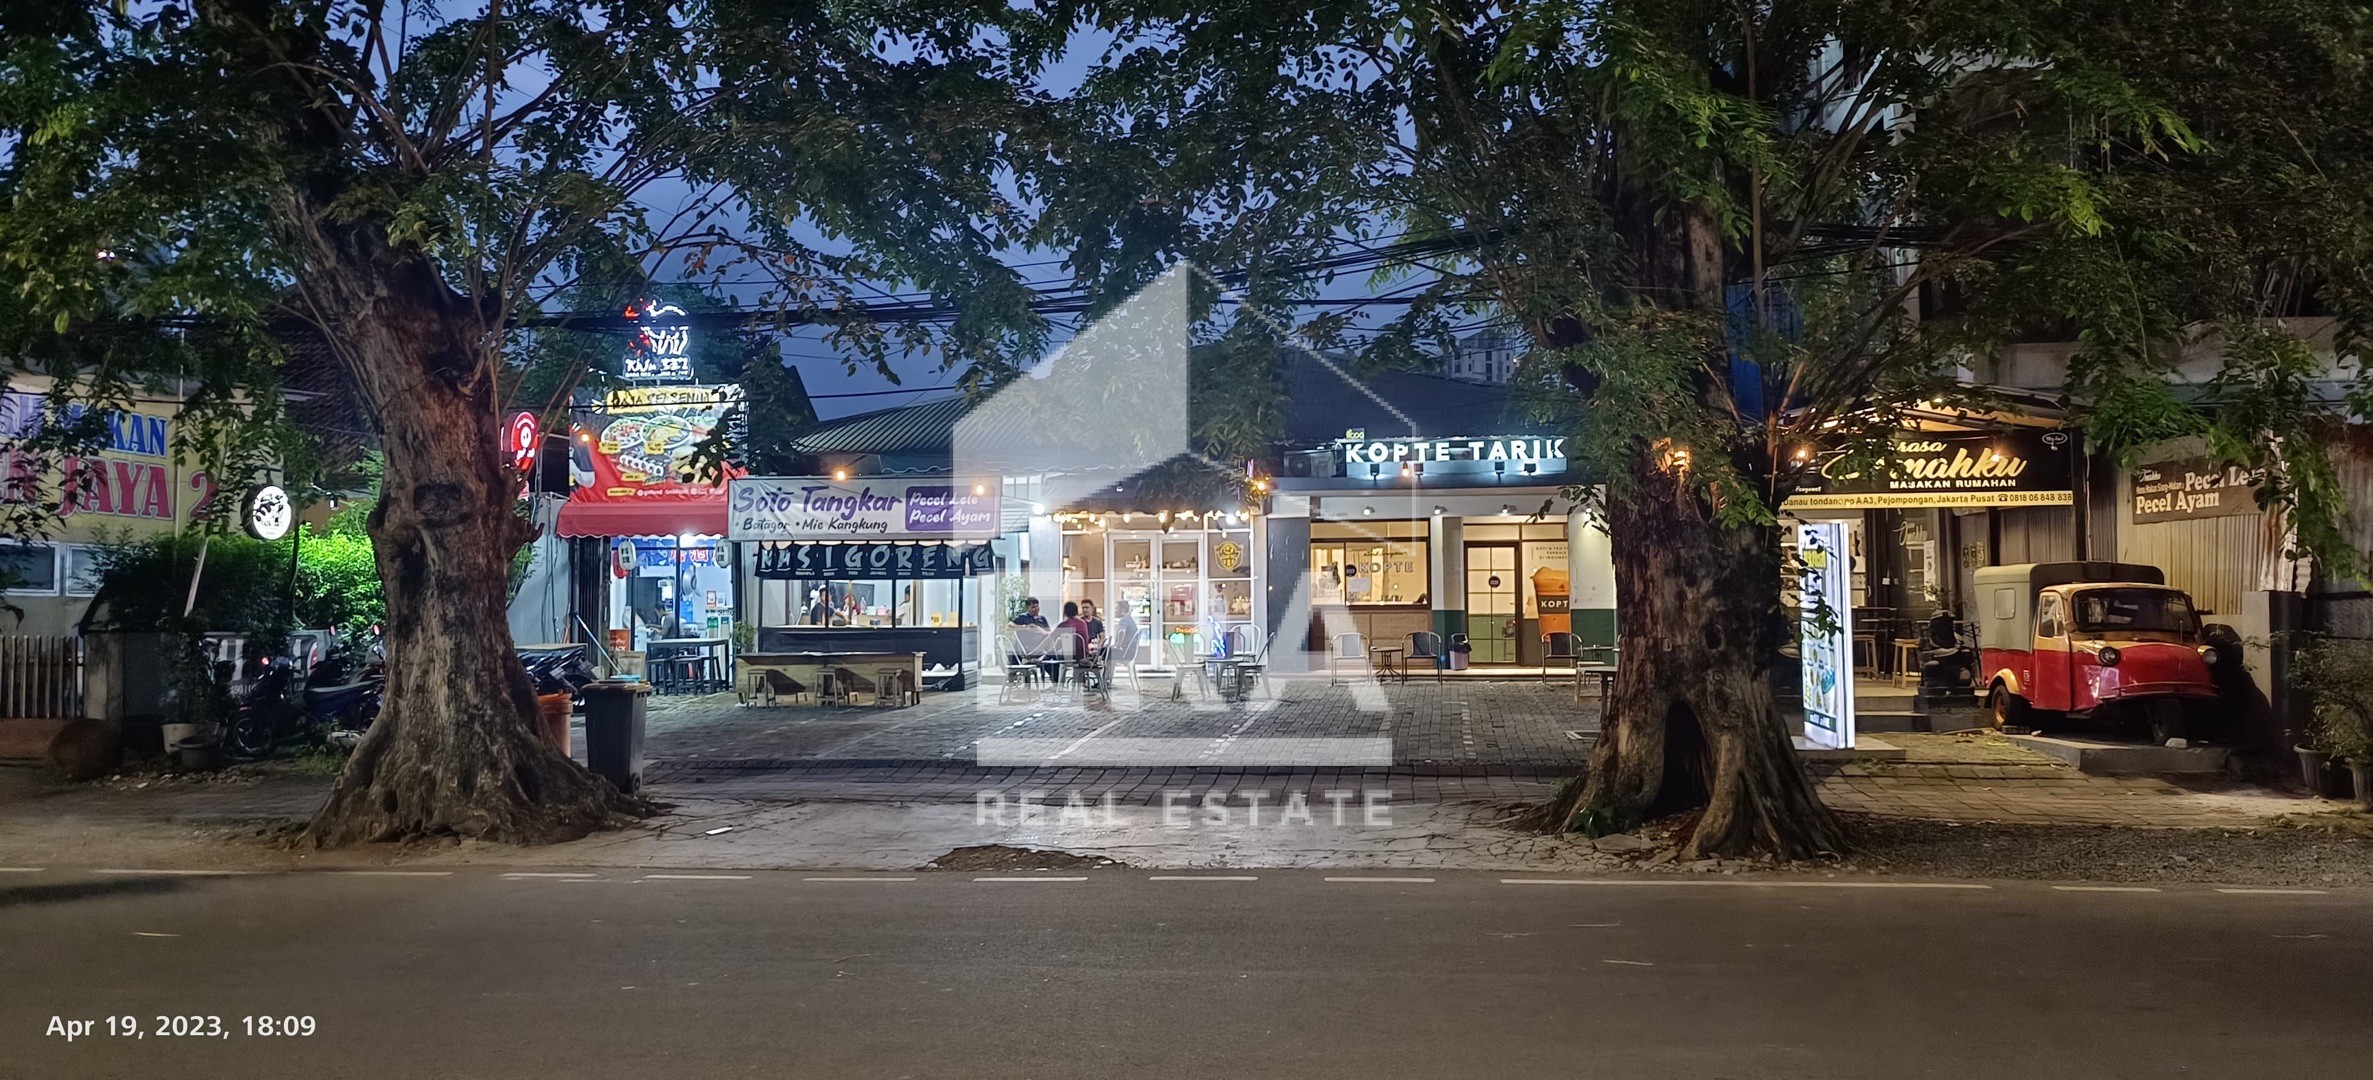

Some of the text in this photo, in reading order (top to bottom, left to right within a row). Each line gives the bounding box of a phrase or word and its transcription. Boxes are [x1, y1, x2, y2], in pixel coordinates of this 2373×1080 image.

[1346, 438, 1567, 463] KOPTE TARIK
[55, 455, 174, 521] JAYA
[1889, 479, 2017, 489] MASAKAN RUMAHAN
[733, 486, 903, 521] Soto Tangkar
[909, 491, 945, 507] Pecel
[1878, 495, 1936, 504] Pejompongan,
[1937, 494, 1968, 503] Jakarta
[1971, 494, 1995, 503] Pusat
[2009, 493, 2028, 502] 0818
[2029, 493, 2039, 501] 06
[2040, 493, 2055, 501] 848
[2057, 492, 2072, 501] 838
[2135, 491, 2220, 514] Pecel Ayam
[742, 517, 888, 533] Batagor Mie Kangkung
[909, 507, 991, 526] Pecel Ayam
[1359, 561, 1414, 573] KOPTE
